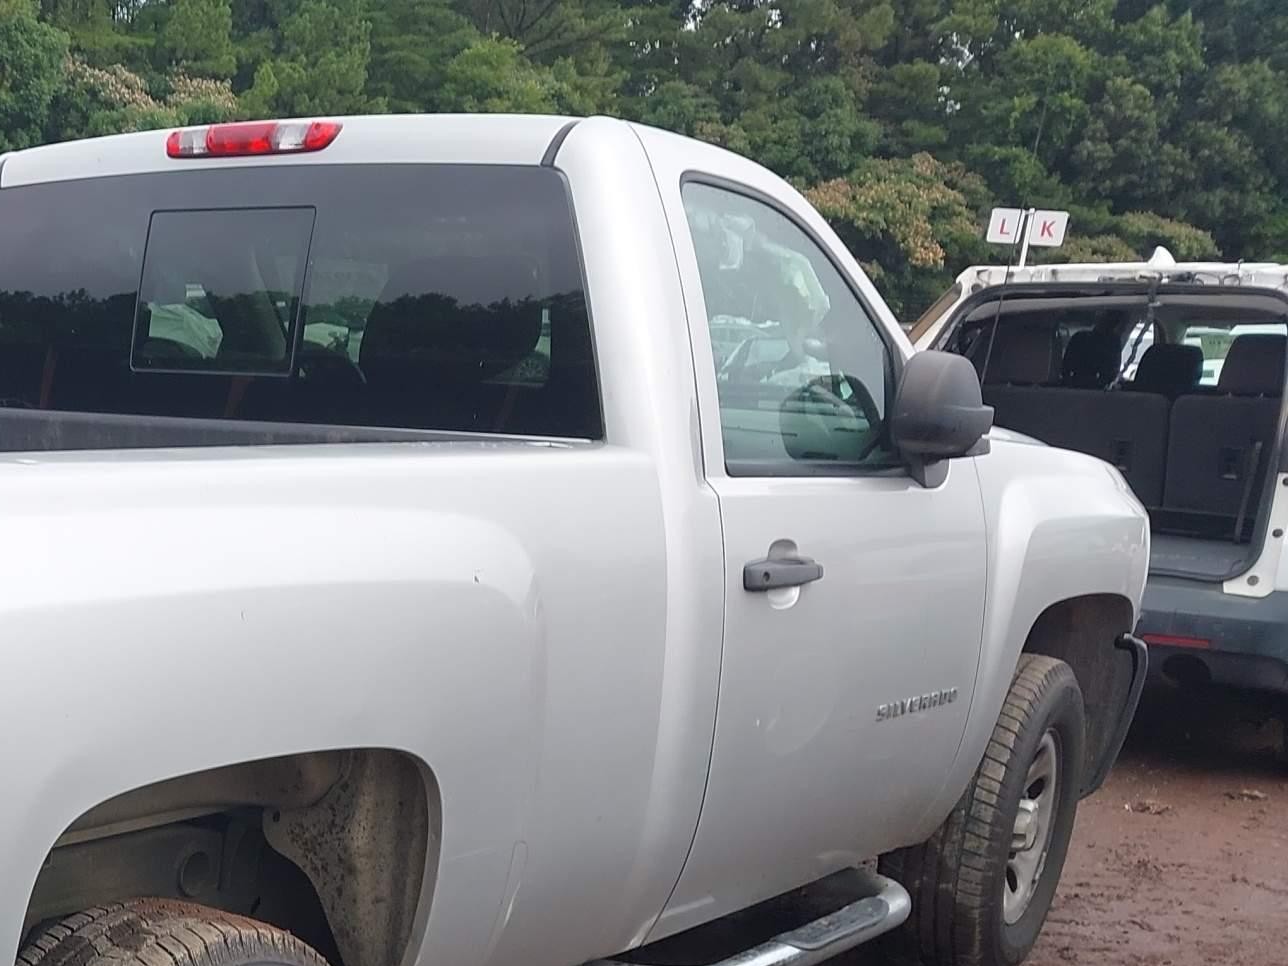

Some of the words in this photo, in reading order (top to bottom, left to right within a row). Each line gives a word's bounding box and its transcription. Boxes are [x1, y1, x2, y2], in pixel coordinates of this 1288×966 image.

[999, 218, 1010, 235] L
[1040, 220, 1056, 238] K
[875, 687, 958, 722] SILVERADO
